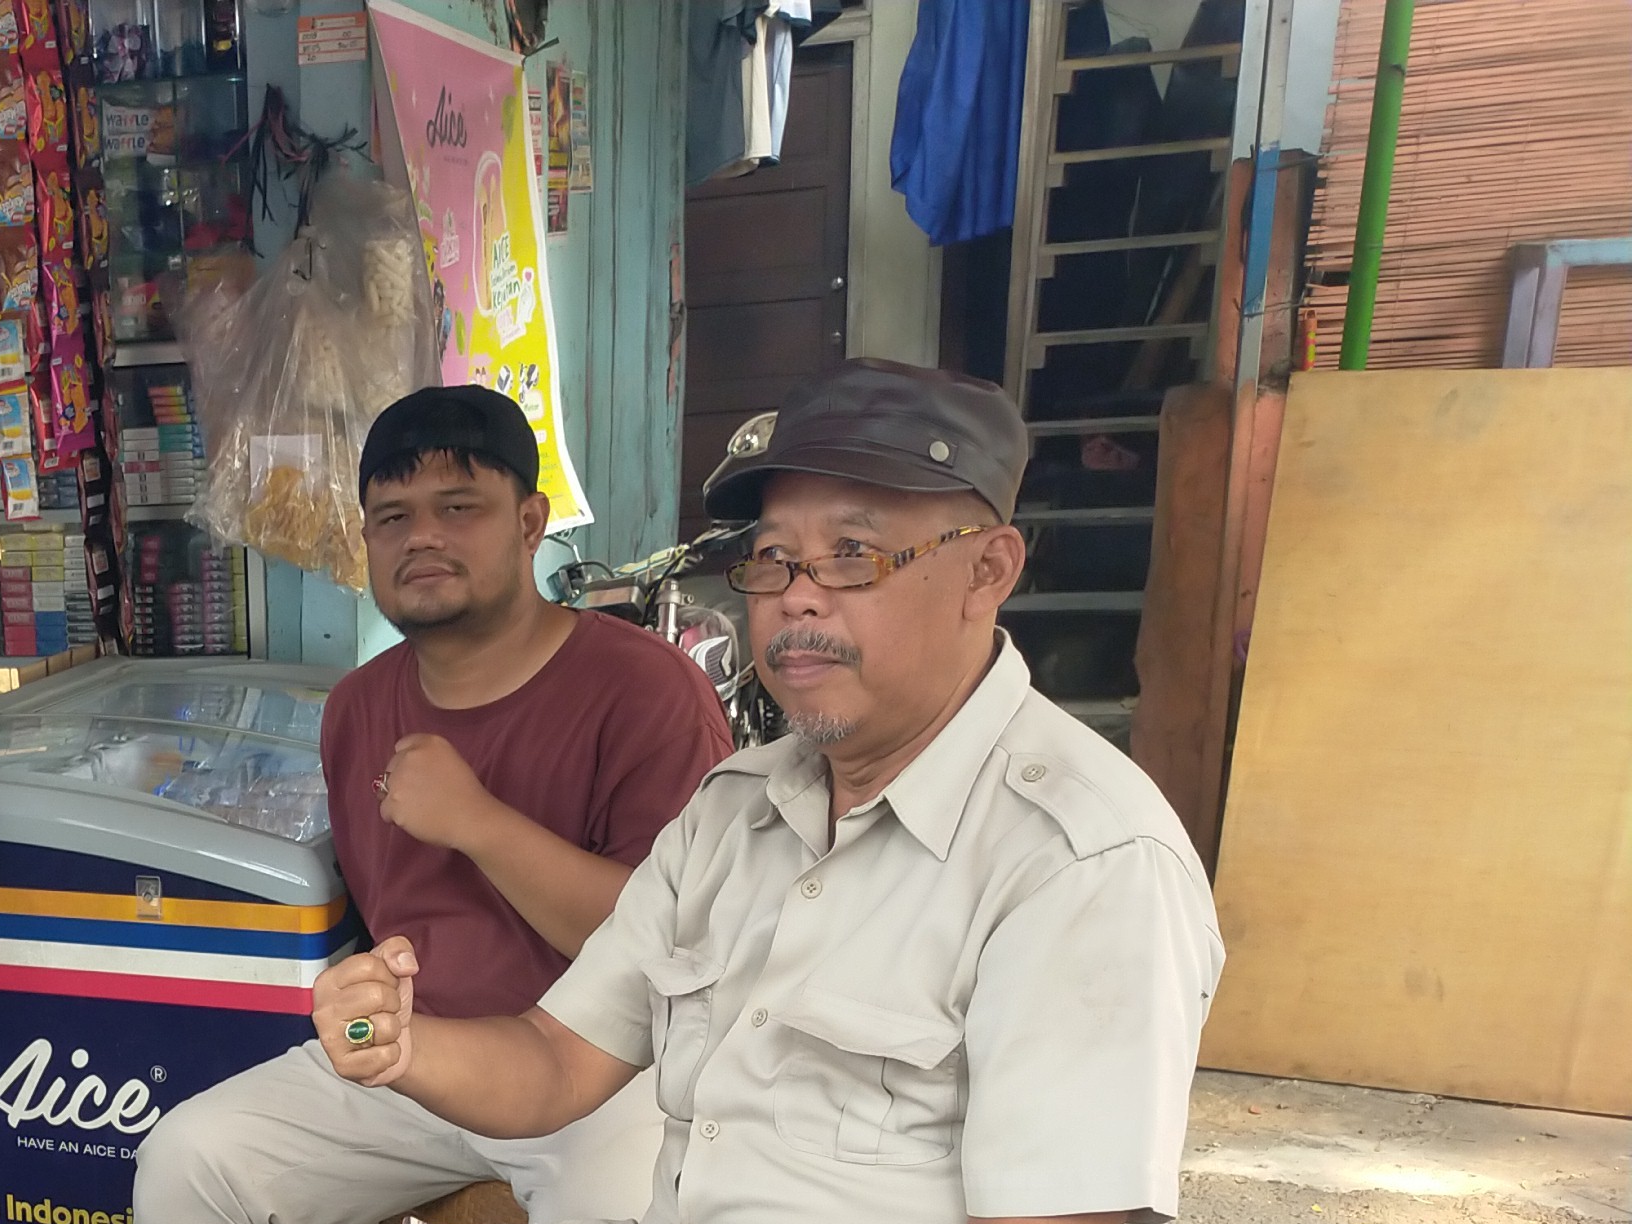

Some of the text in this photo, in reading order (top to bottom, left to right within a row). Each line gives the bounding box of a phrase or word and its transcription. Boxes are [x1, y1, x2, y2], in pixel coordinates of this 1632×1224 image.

[106, 113, 150, 127] waffle
[426, 86, 467, 149] Aice
[105, 135, 146, 150] waffle
[17, 1136, 137, 1160] HAVE AN AICE DA
